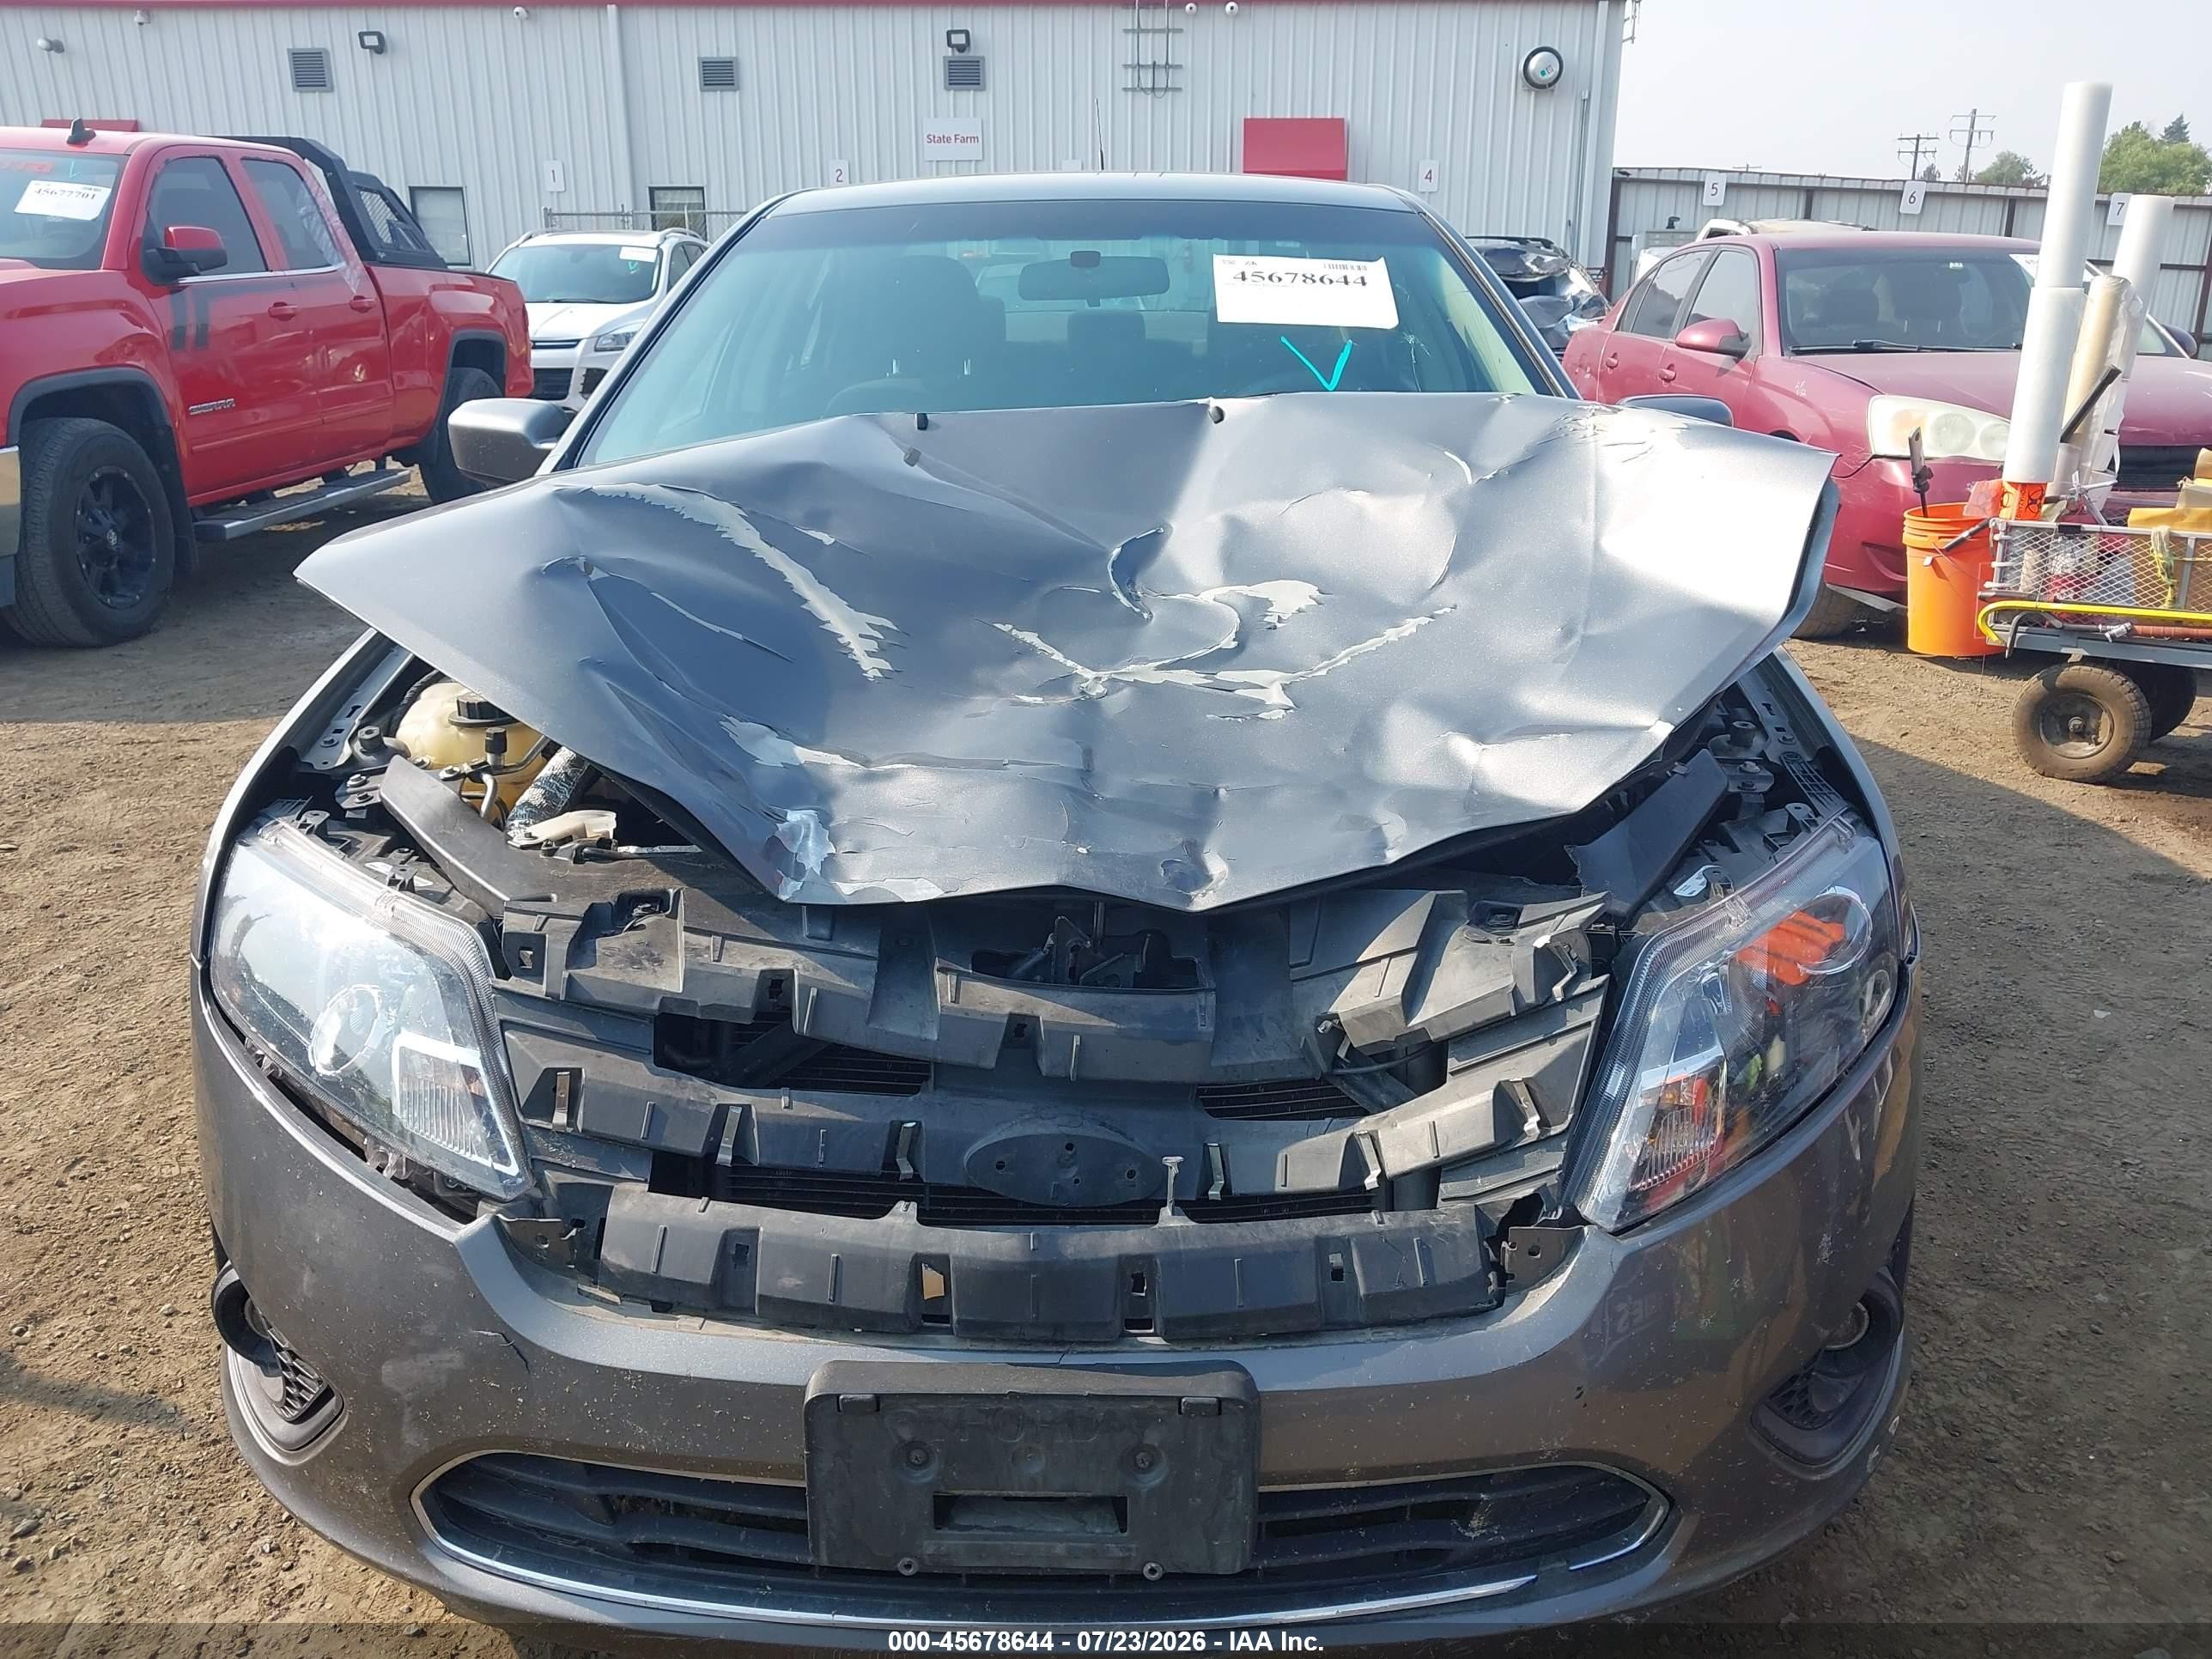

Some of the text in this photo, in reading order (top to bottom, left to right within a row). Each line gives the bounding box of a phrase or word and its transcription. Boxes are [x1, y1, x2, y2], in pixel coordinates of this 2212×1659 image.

[927, 133, 979, 144] State Farm
[551, 169, 556, 183] 1
[836, 168, 843, 183] 2
[1425, 168, 1432, 183] 4
[1711, 182, 1719, 197] 5
[1908, 190, 1917, 204] 6
[2117, 202, 2125, 216] 7
[1233, 270, 1368, 287] 45678644
